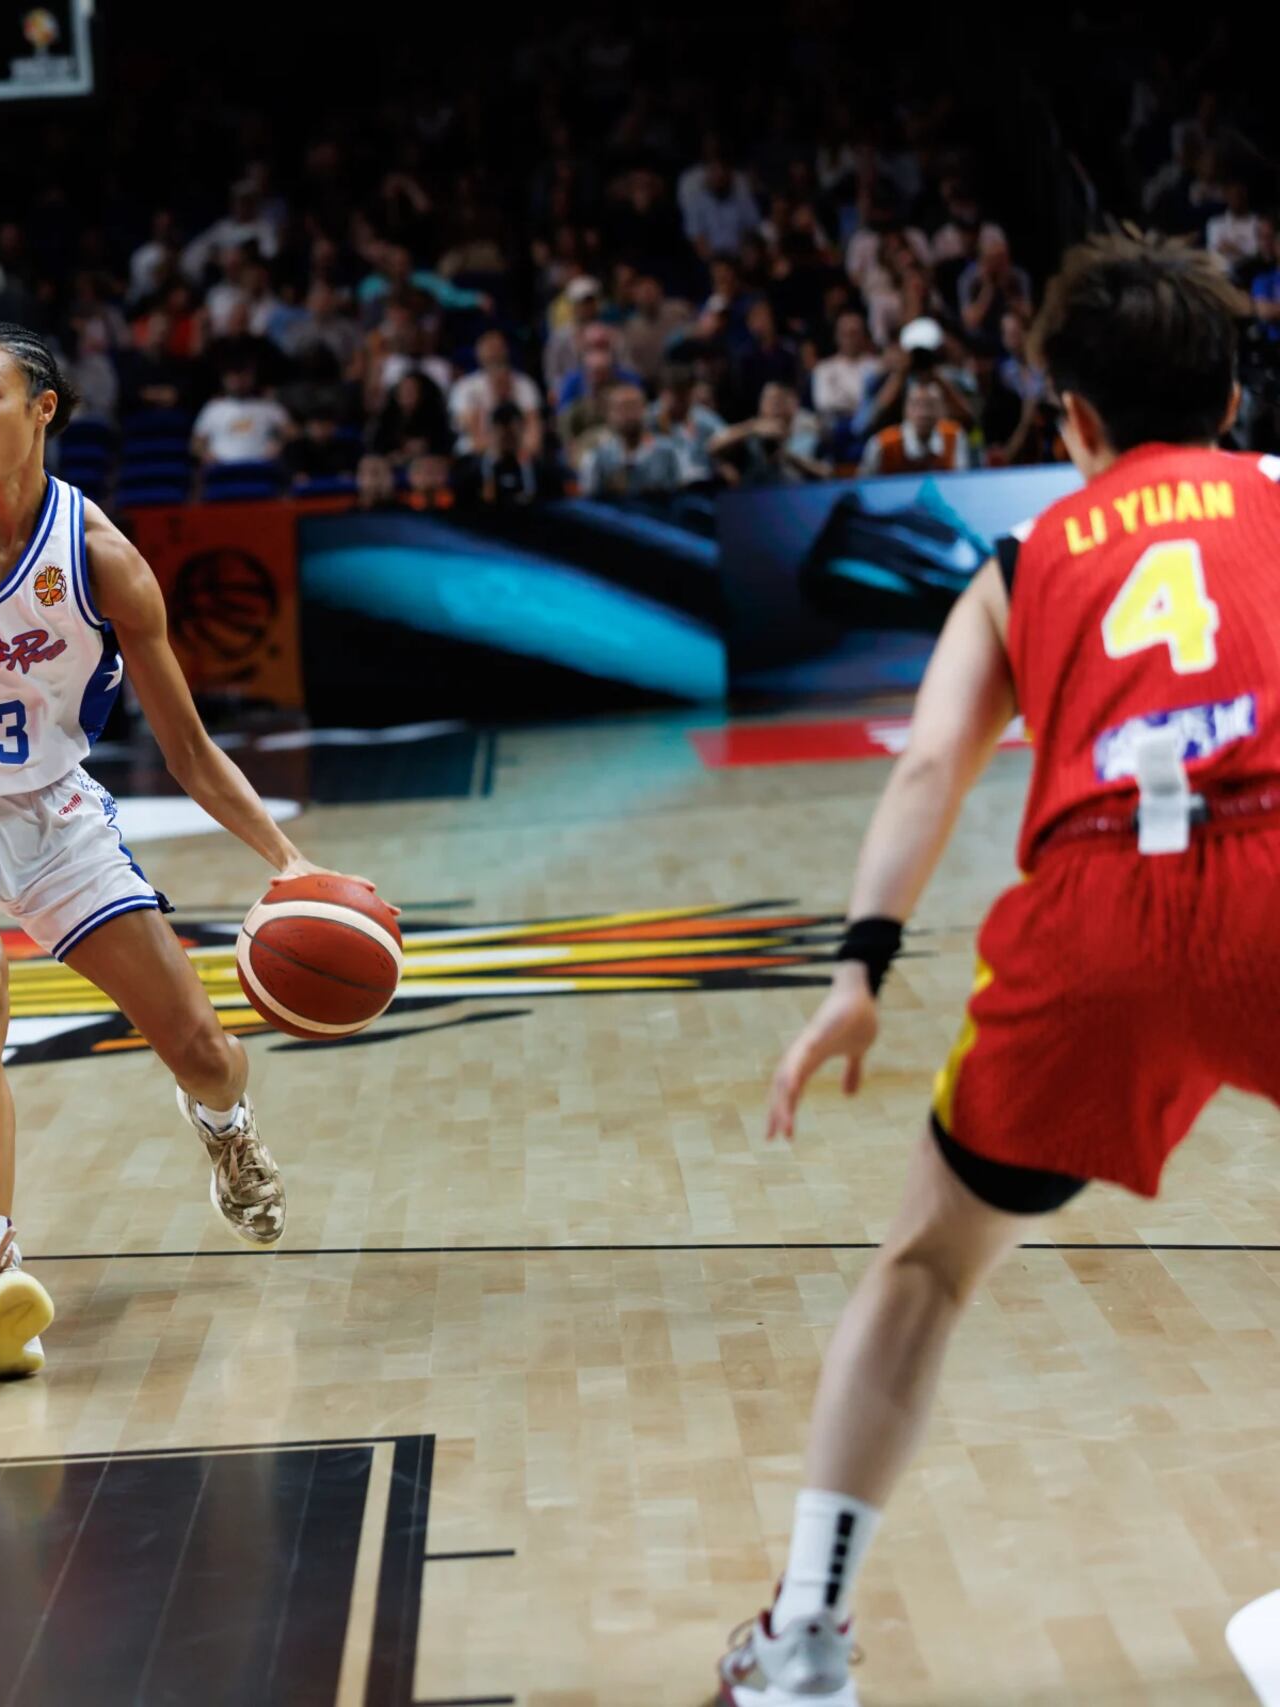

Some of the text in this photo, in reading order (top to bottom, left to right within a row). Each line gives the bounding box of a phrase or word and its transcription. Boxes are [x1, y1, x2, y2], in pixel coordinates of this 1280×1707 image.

[1064, 480, 1235, 555] LI YUAN
[1101, 538, 1219, 675] 4
[6, 629, 68, 674] Rico
